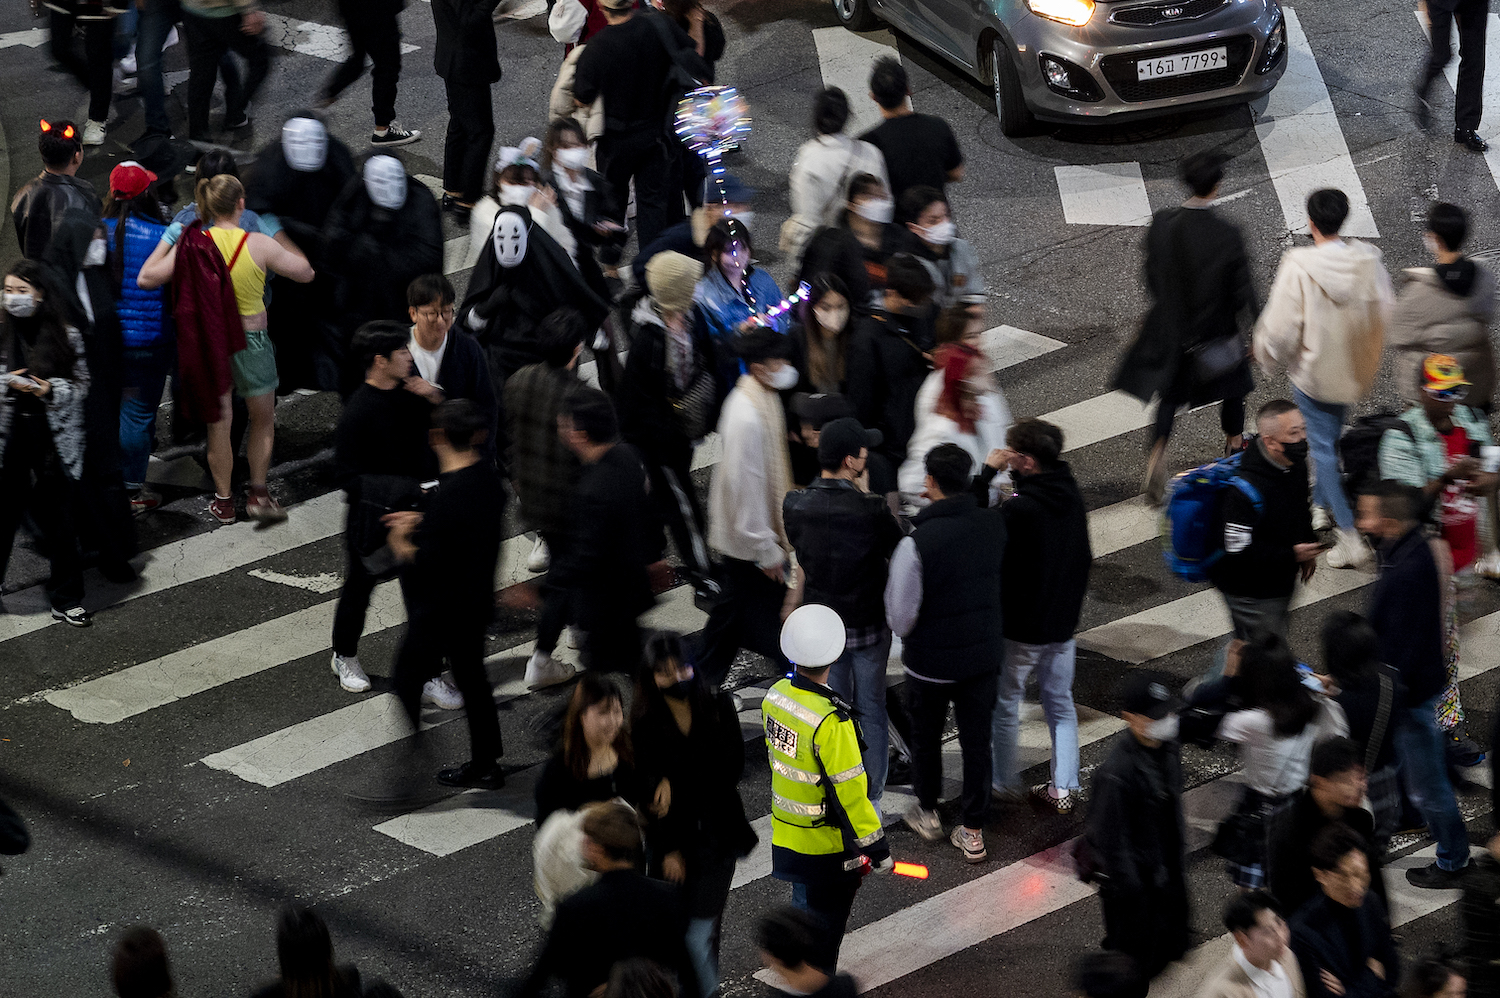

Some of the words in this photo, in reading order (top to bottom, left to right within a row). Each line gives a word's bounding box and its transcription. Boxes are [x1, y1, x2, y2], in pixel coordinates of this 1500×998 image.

[1164, 8, 1182, 17] KIA
[1146, 59, 1175, 76] 16고
[1181, 52, 1219, 71] 7799
